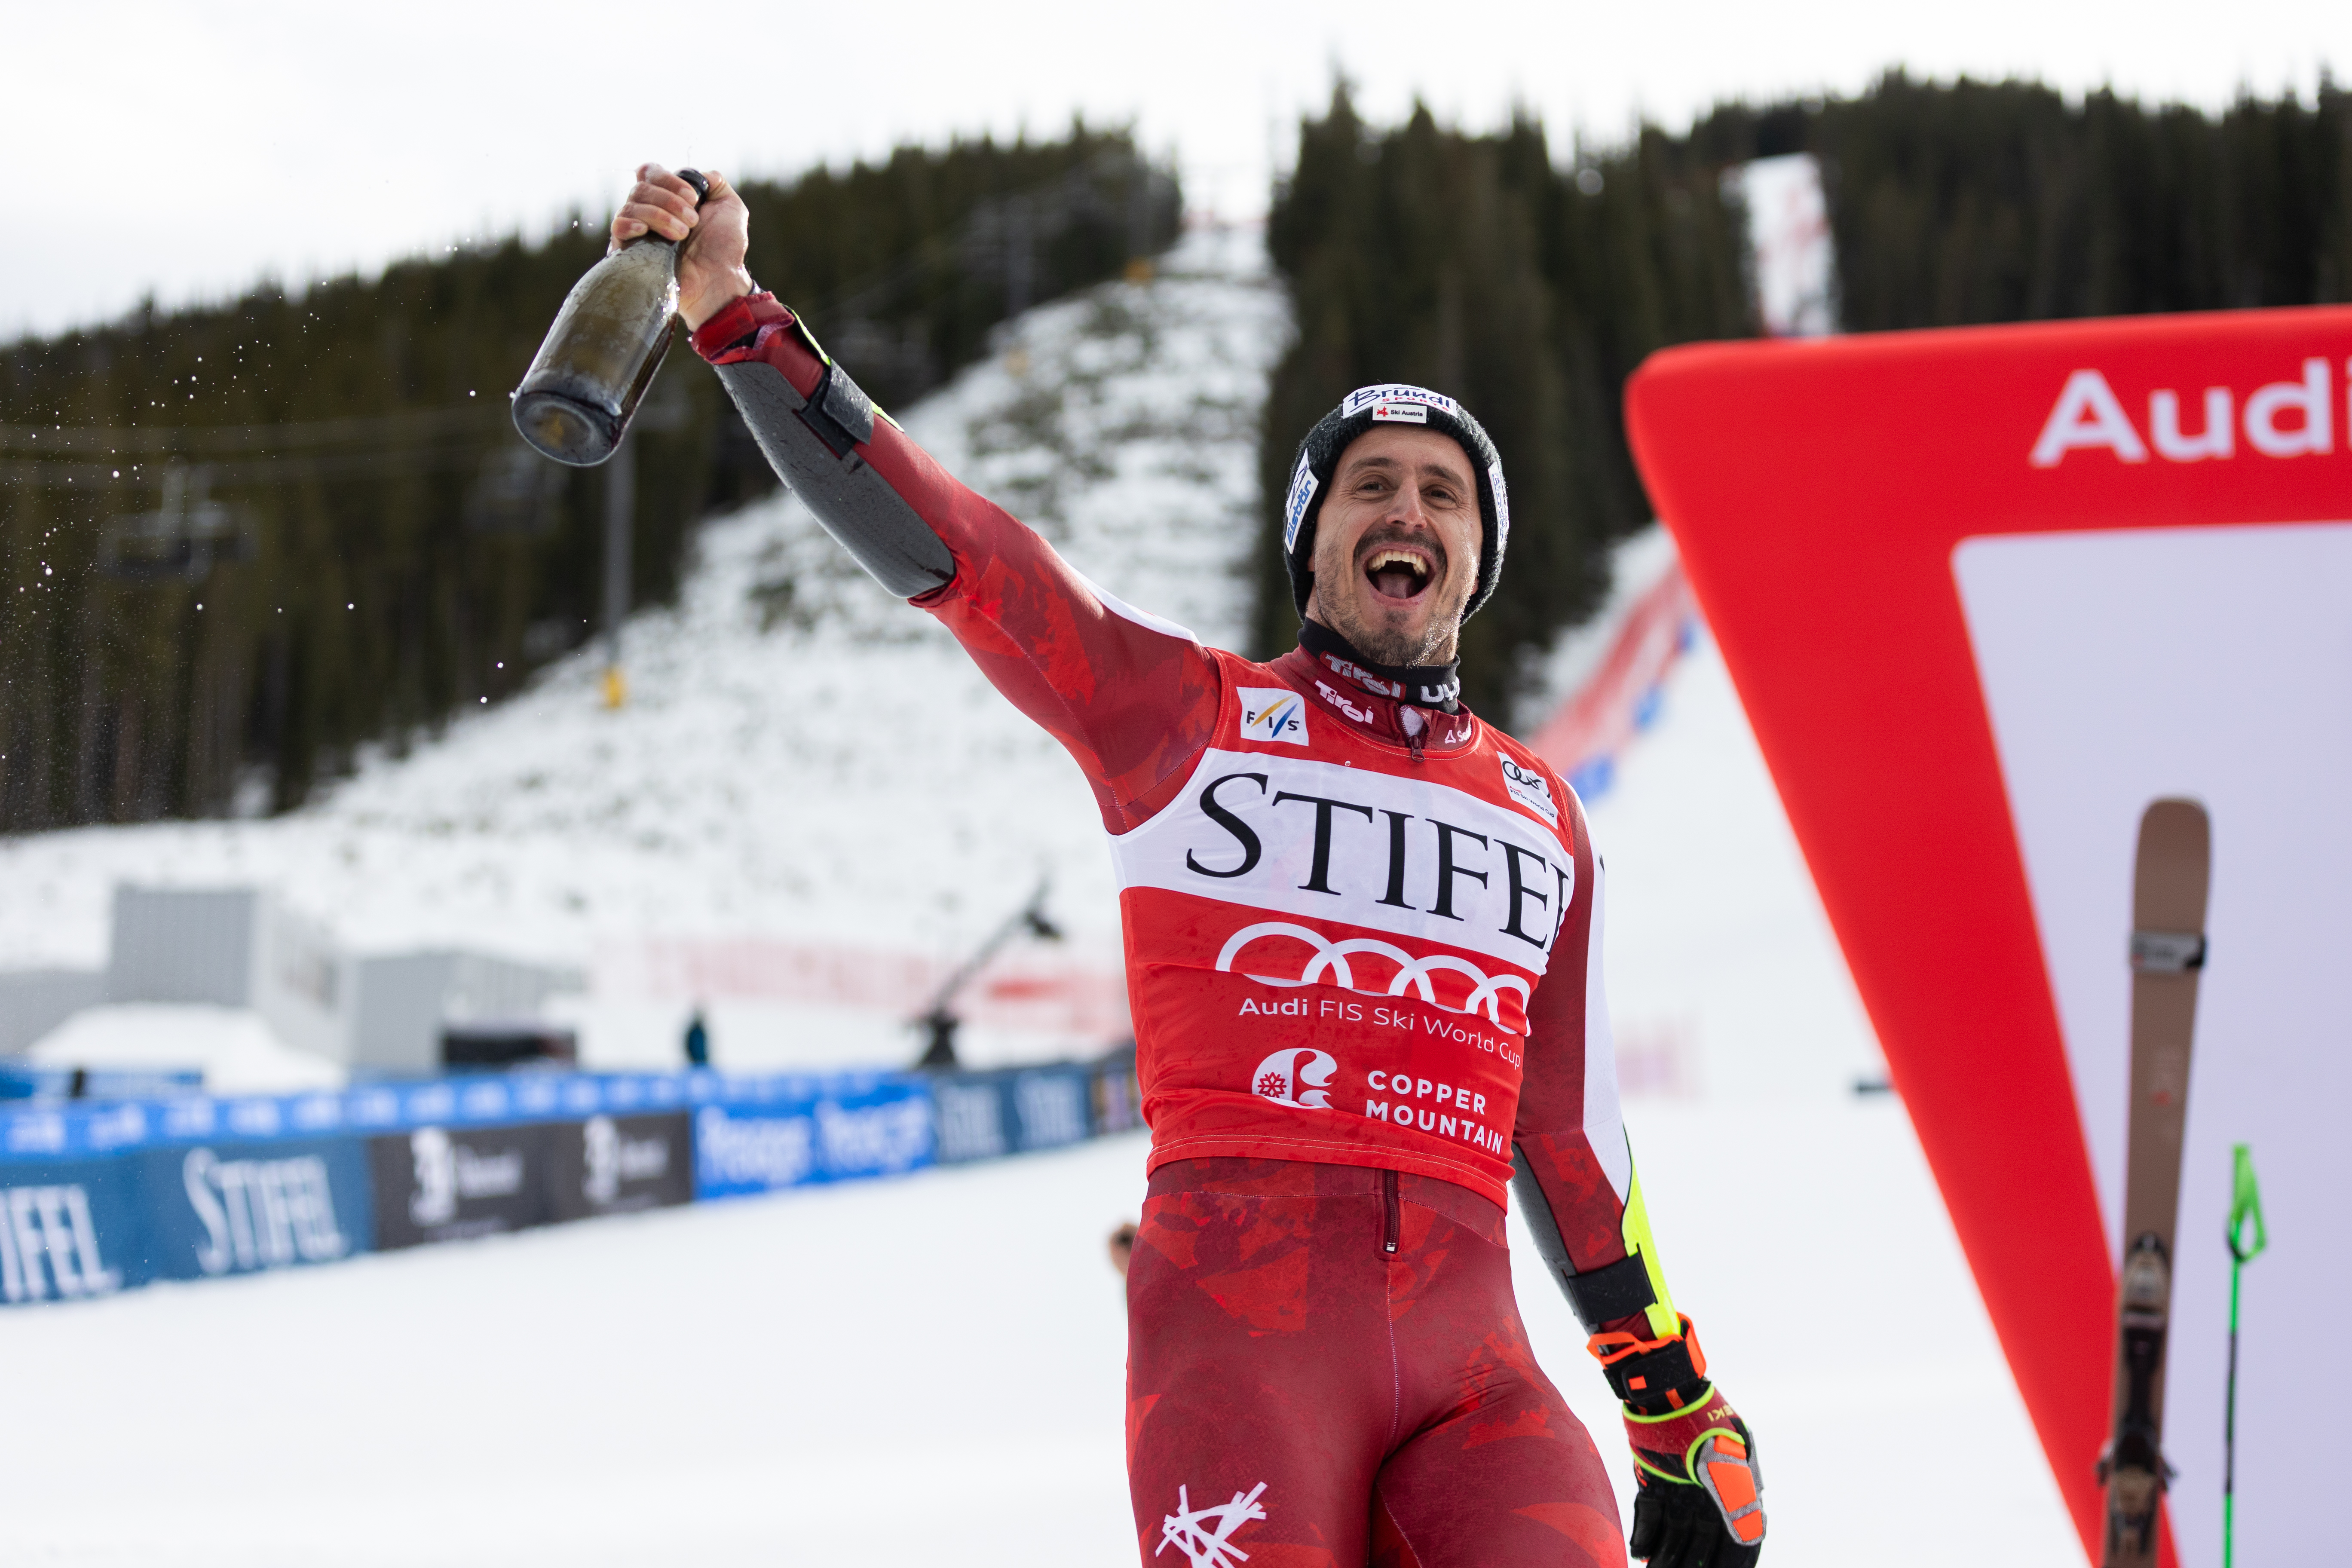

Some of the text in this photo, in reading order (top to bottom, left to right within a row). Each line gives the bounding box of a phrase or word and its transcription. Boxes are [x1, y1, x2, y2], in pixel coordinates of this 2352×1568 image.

[1382, 397, 1449, 411] SPORTS
[2028, 356, 2352, 469] Aud
[1287, 480, 1311, 546] Eisbär
[1509, 785, 1522, 793] Audi
[1529, 799, 1544, 811] World
[1545, 808, 1555, 818] Cup
[1238, 998, 1521, 1070] Audi FIS Ski World Cup
[1368, 1070, 1486, 1115] COPPER
[1366, 1099, 1503, 1155] MOUNTAIN
